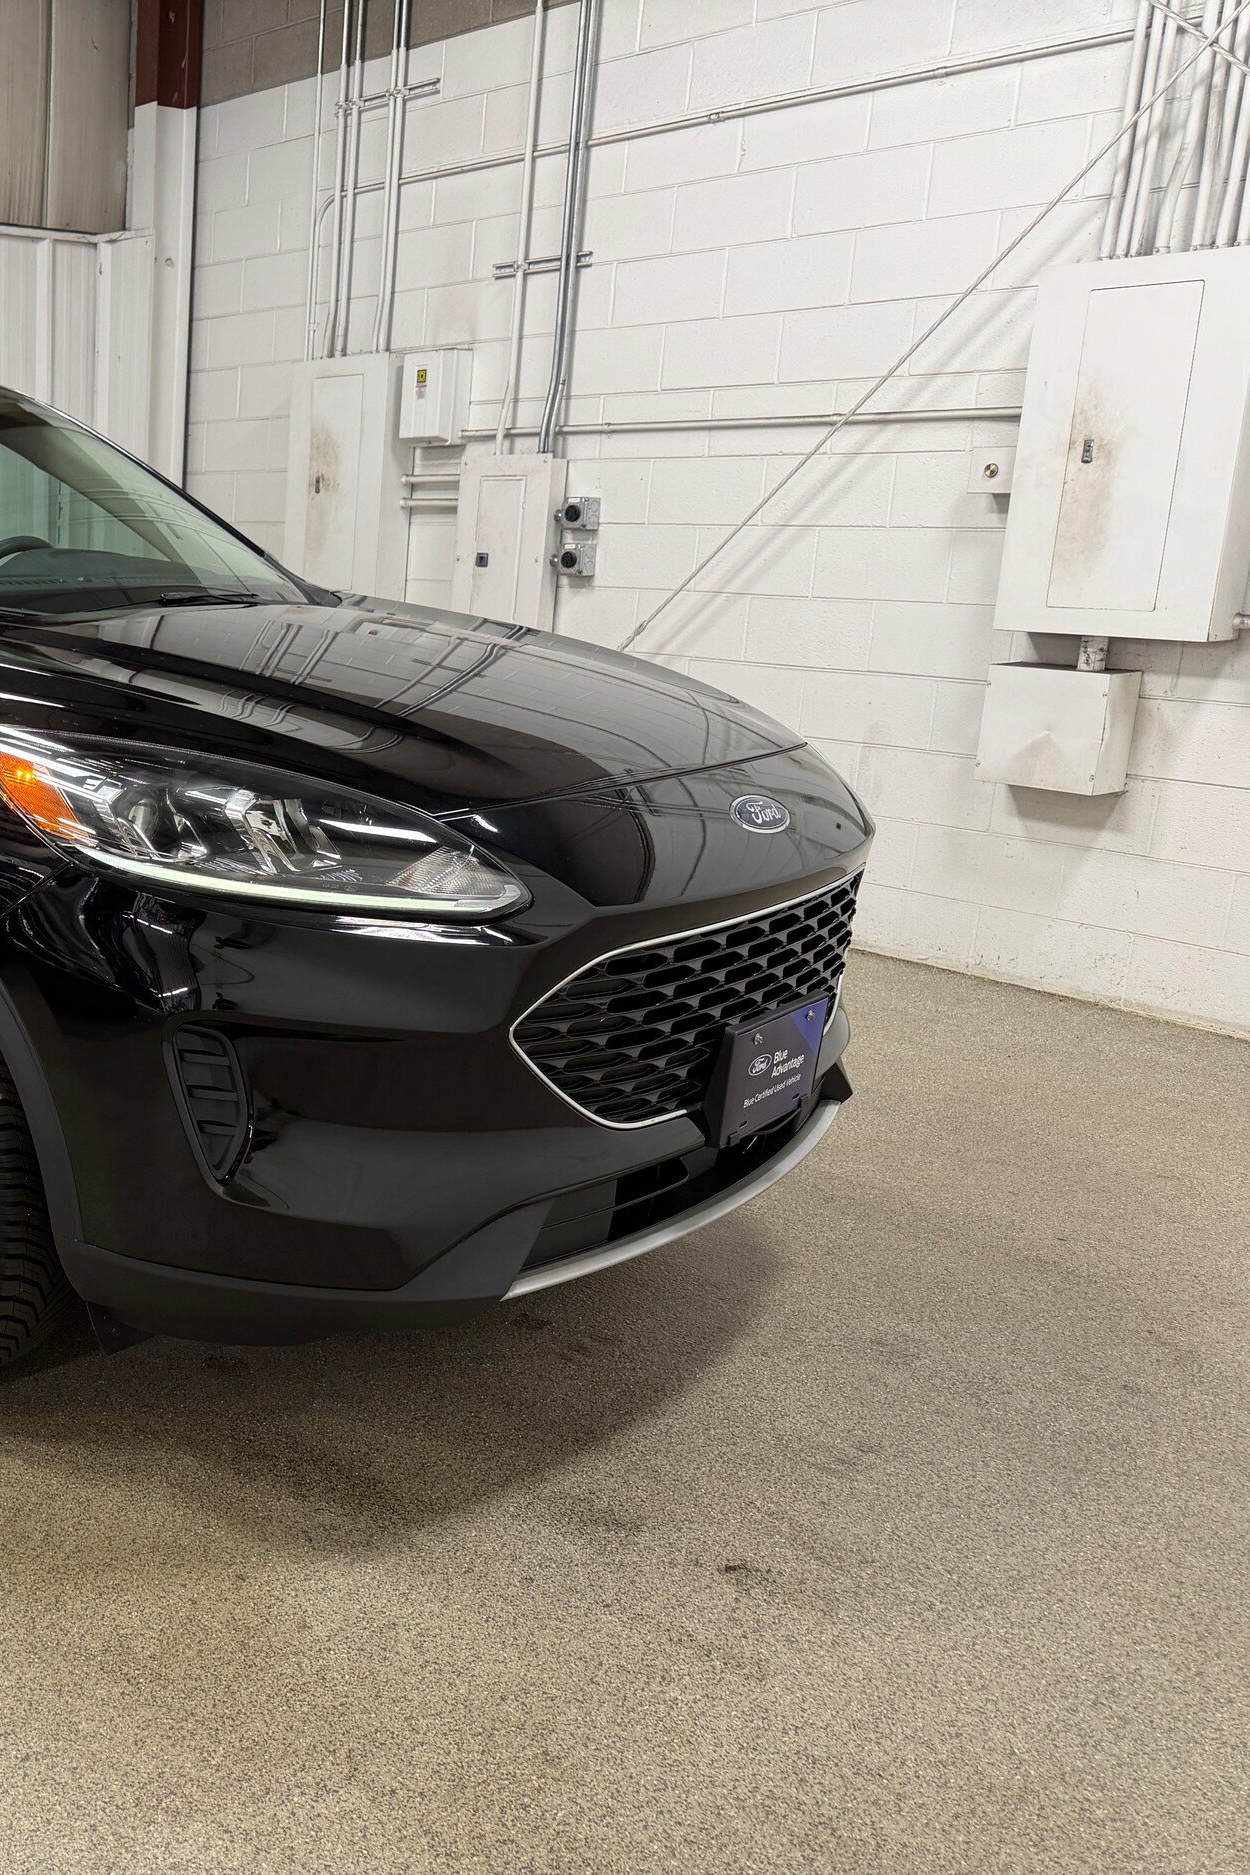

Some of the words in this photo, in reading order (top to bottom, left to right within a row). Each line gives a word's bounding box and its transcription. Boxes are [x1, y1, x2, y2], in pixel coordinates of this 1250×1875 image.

[746, 801, 781, 824] Ford
[771, 1055, 805, 1078] Advantage
[773, 1049, 788, 1064] Blue
